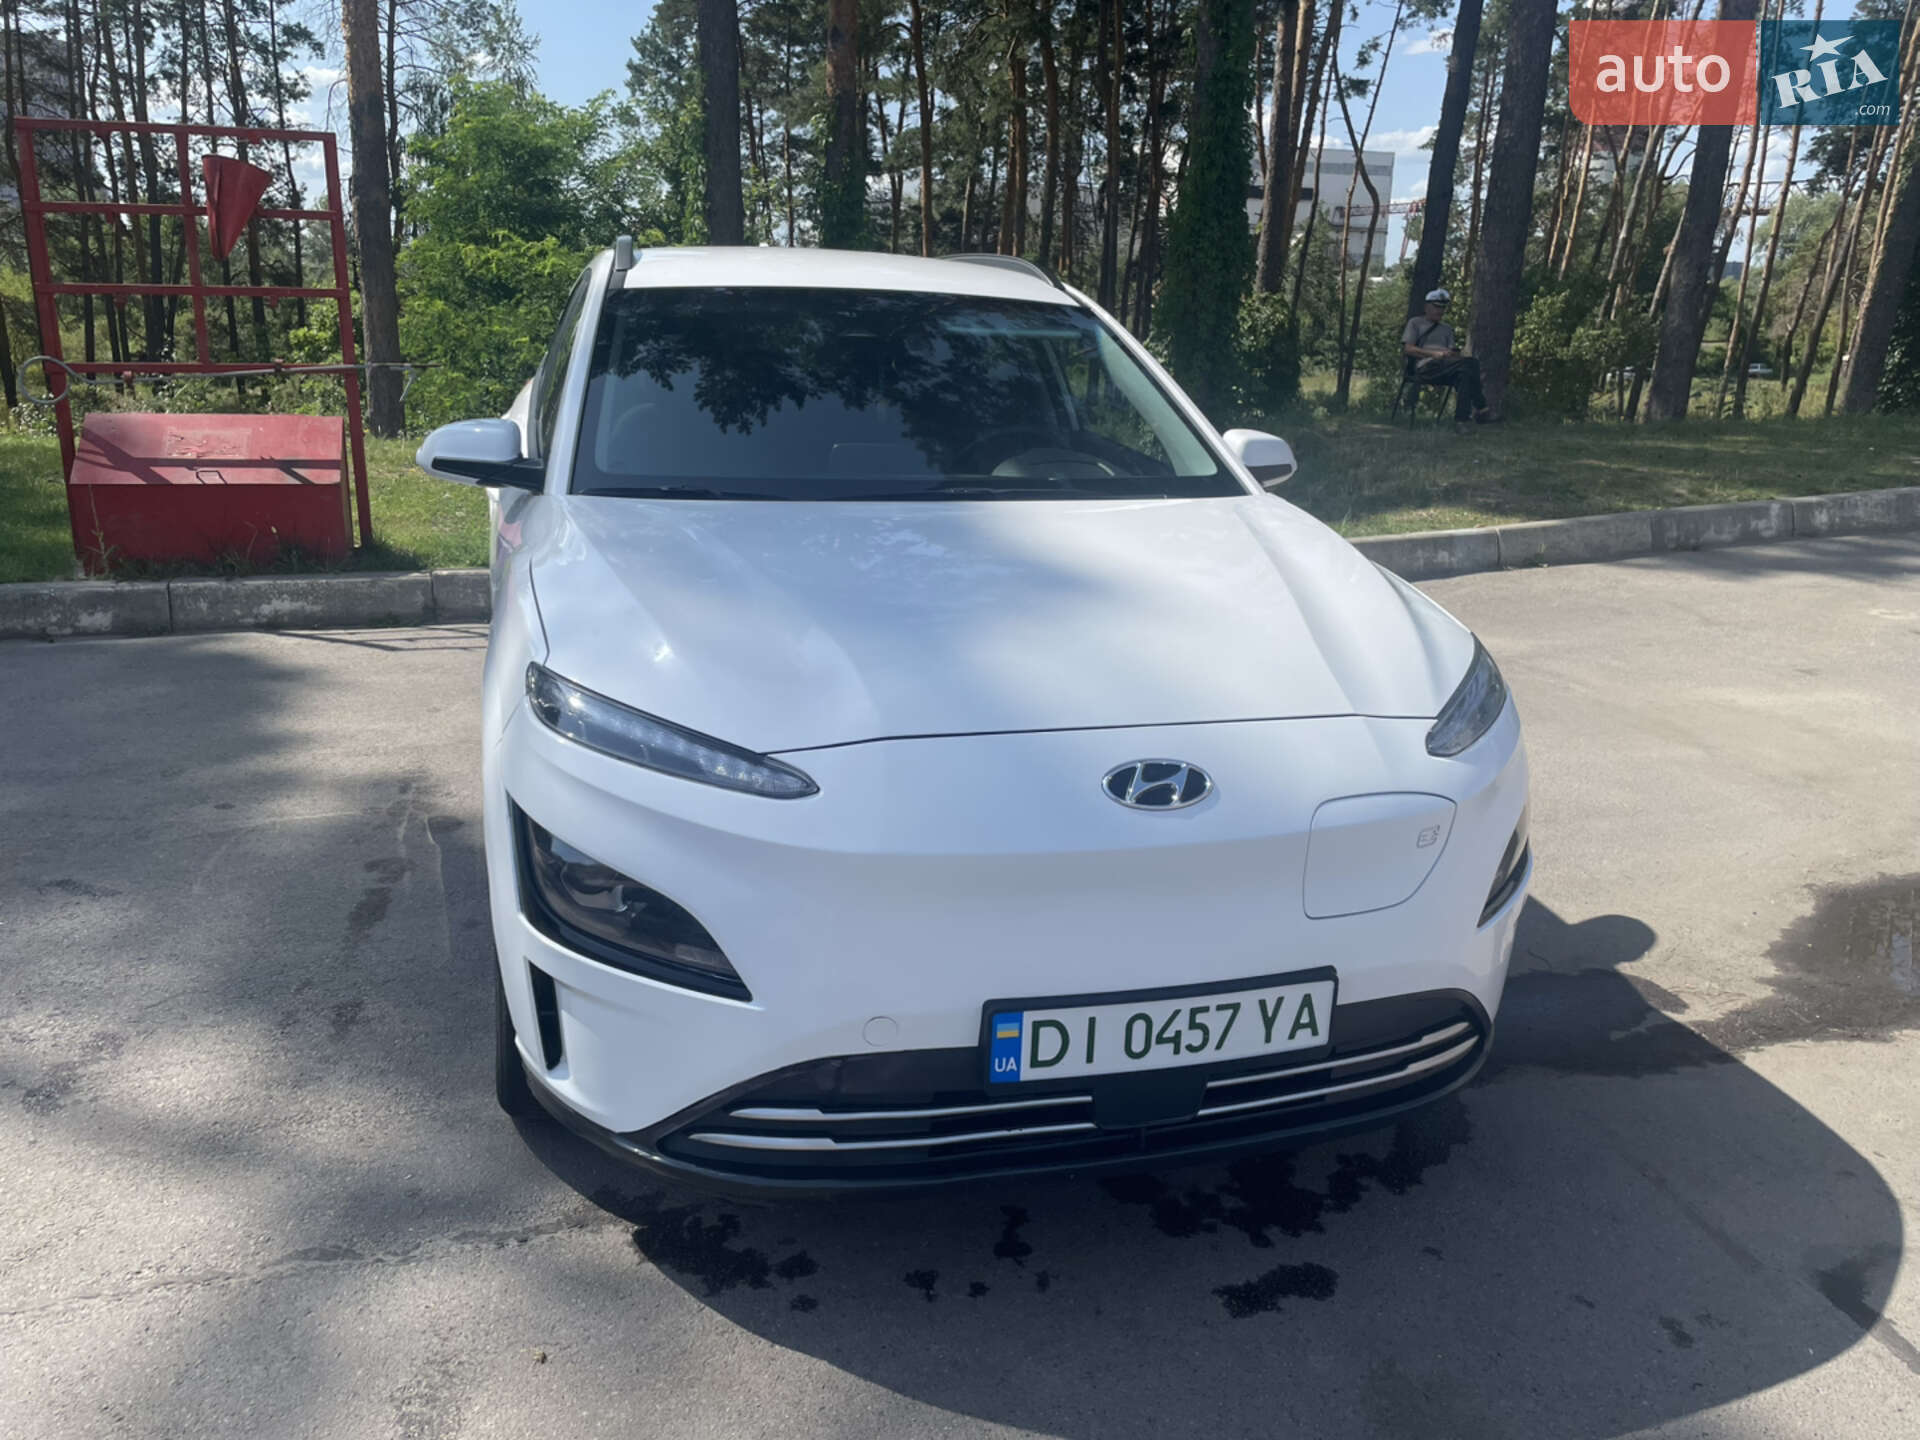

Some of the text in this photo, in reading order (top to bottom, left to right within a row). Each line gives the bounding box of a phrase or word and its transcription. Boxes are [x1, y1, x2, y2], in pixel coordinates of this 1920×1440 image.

[1029, 993, 1319, 1069] DI 0457 YA
[994, 1057, 1018, 1073] UA
